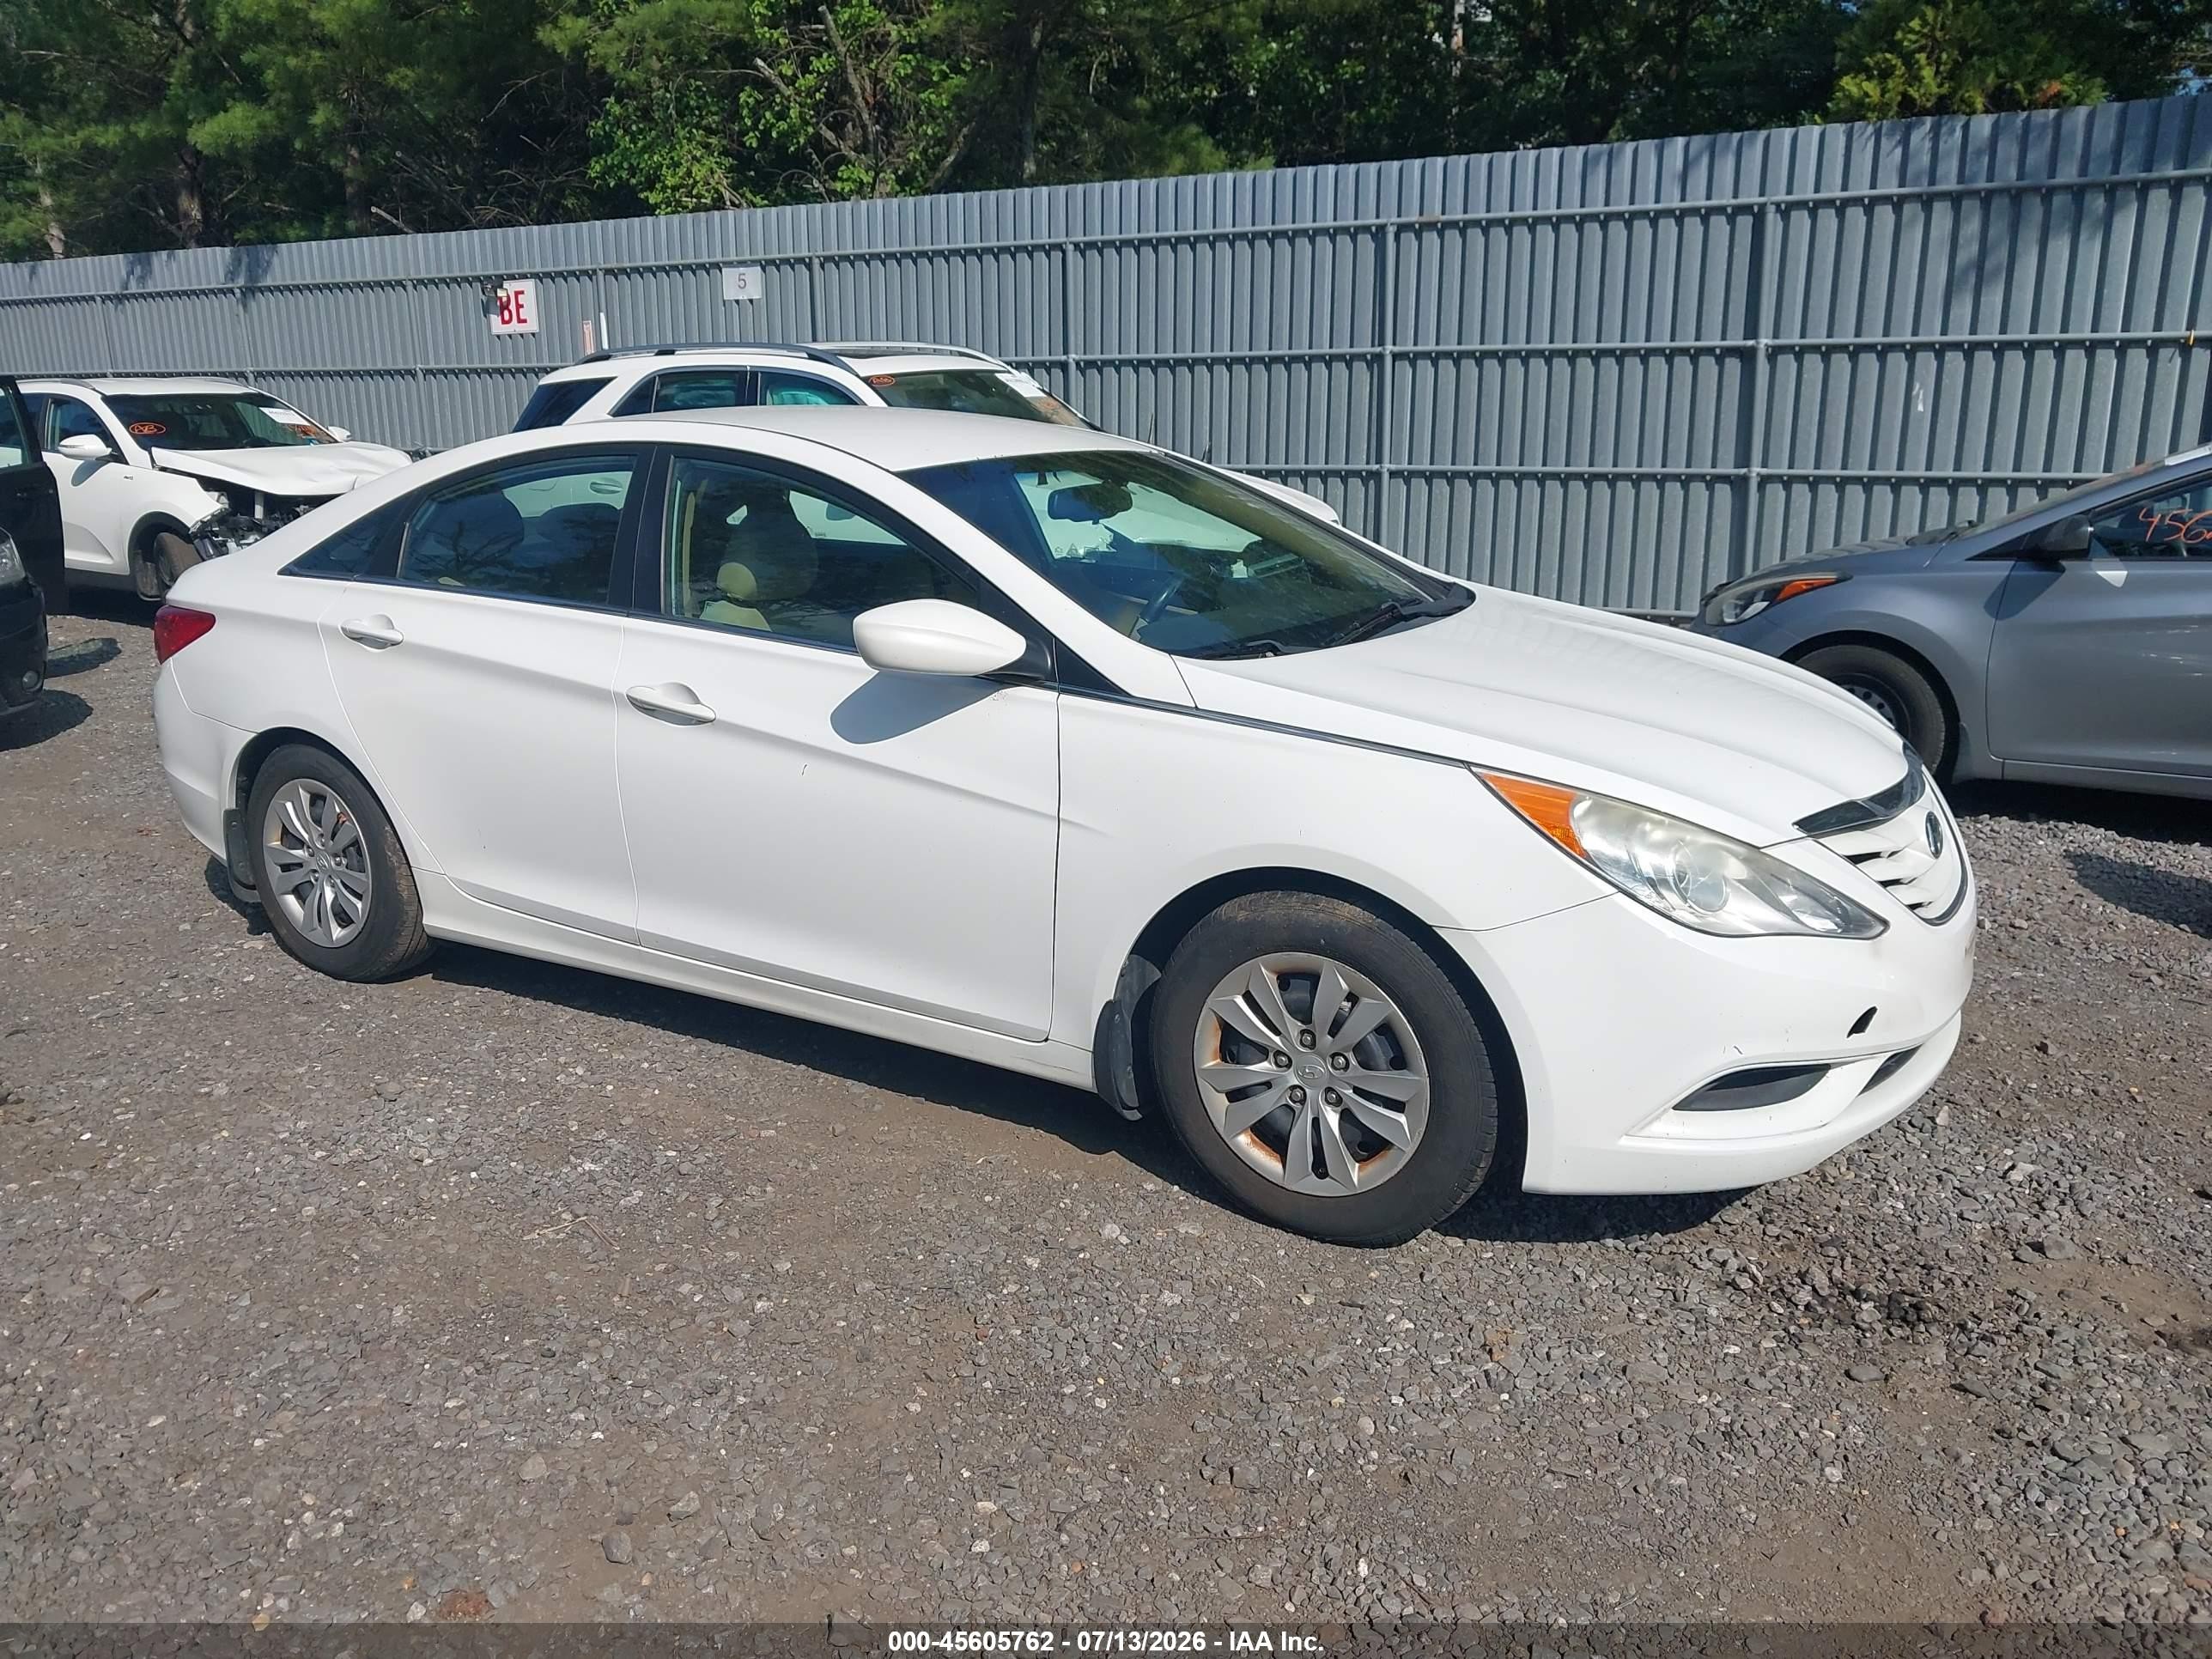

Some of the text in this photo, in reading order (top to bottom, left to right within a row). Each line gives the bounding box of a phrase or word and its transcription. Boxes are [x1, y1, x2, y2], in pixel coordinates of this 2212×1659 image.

[738, 273, 747, 289] 5
[497, 290, 527, 325] BE
[2139, 508, 2212, 544] 456
